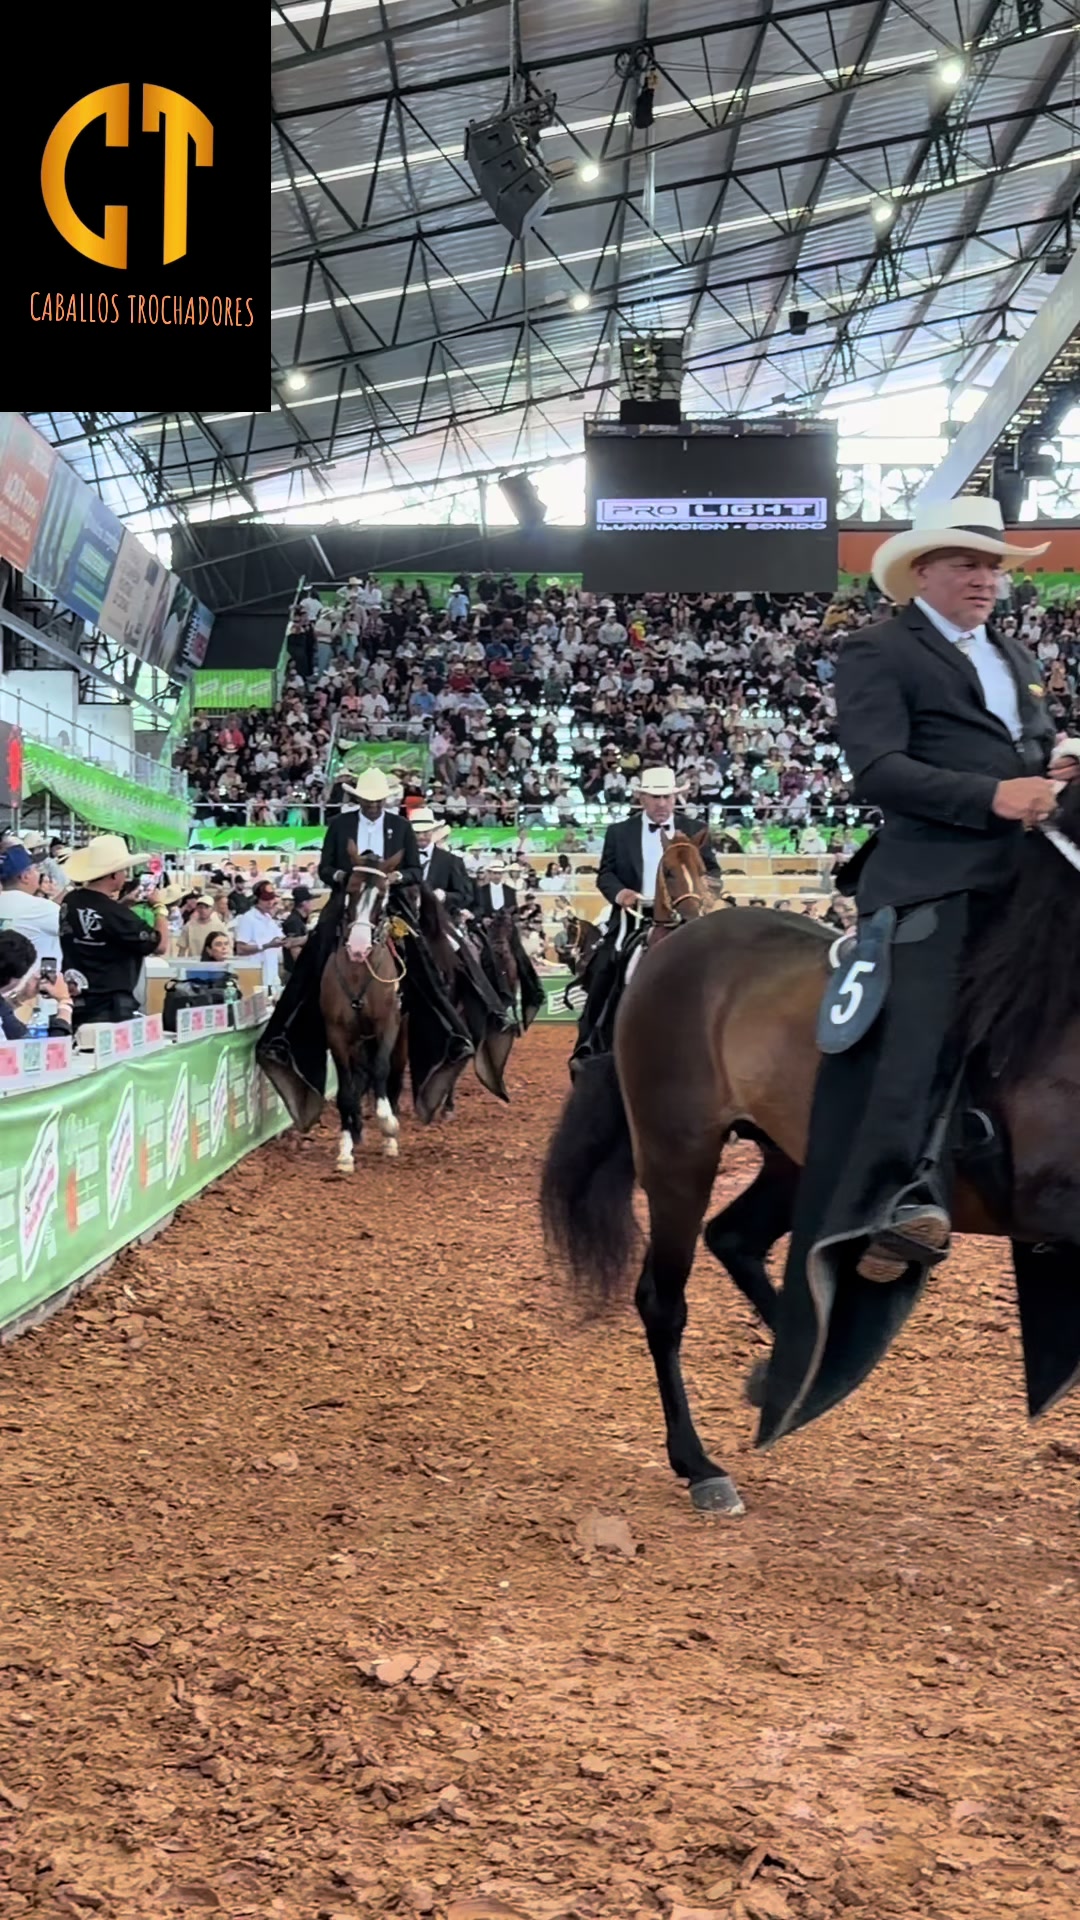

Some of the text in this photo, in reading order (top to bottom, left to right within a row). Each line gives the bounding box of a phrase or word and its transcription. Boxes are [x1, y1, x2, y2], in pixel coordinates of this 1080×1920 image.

[612, 503, 814, 518] PRO LIGHT
[596, 522, 728, 531] ILUMINACION
[745, 522, 827, 531] SONIDO
[830, 960, 876, 1025] 5
